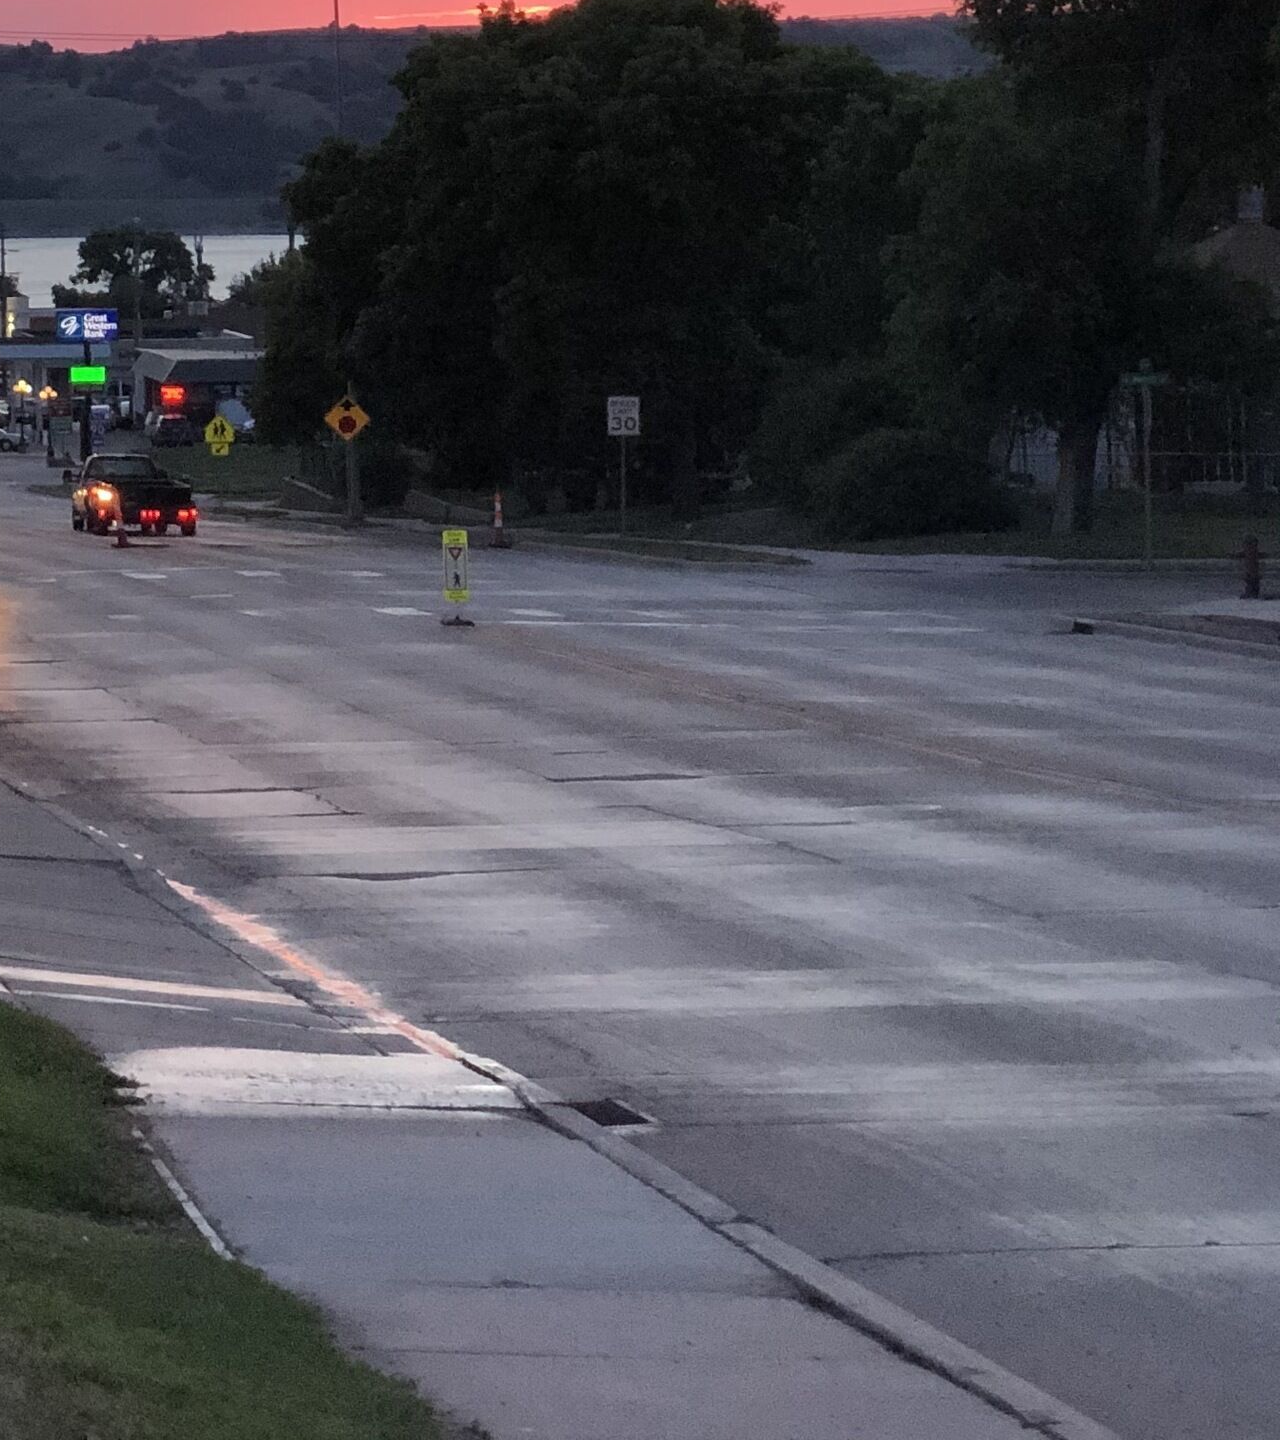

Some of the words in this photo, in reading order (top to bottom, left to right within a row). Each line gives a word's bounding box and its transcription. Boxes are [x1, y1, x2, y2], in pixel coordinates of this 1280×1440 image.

[83, 313, 108, 322] Great
[83, 322, 118, 330] Western
[83, 330, 106, 338] Bank
[610, 416, 638, 431] 30
